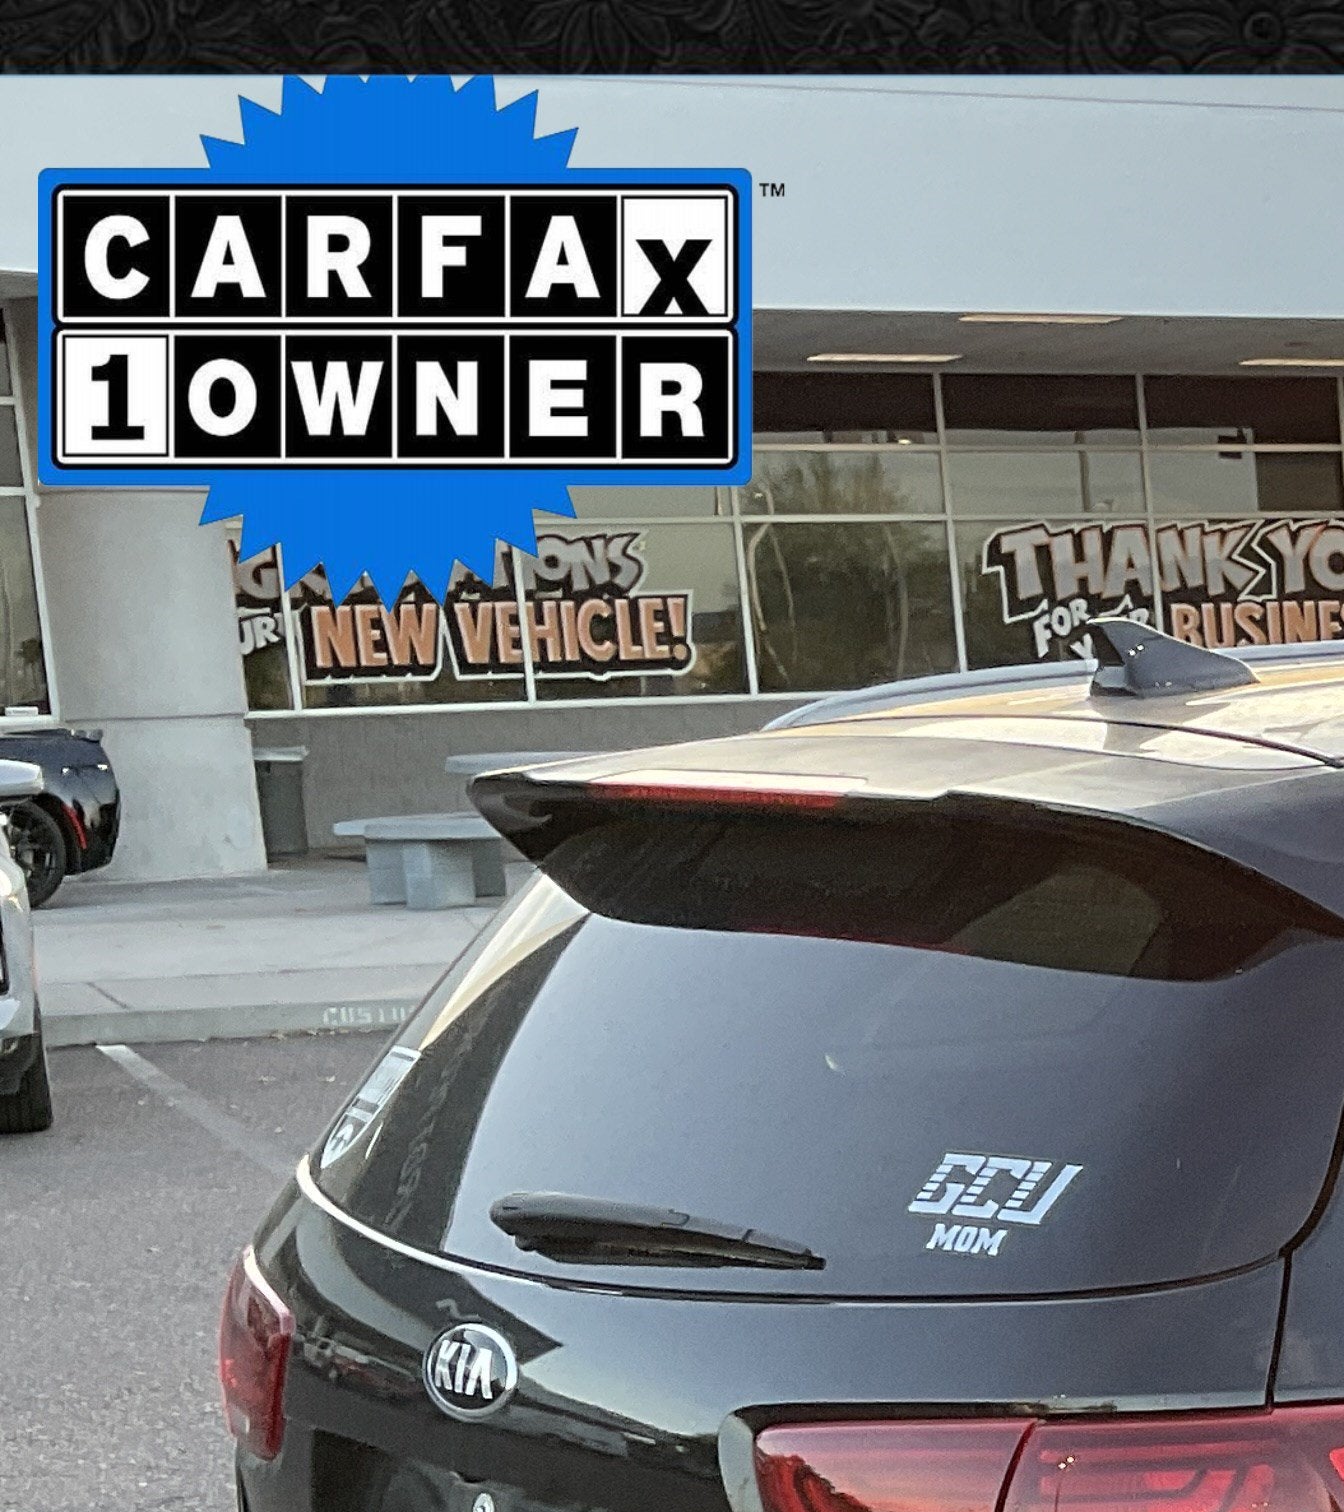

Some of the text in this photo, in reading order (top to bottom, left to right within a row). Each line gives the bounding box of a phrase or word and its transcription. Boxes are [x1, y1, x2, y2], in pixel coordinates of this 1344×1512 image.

[1000, 524, 1257, 600] THANK
[311, 596, 688, 668] NEW VEHICLE!
[1033, 598, 1091, 658] FOR
[908, 1153, 1084, 1225] GCU
[926, 1223, 1009, 1257] MOM
[435, 1339, 493, 1400] KIA
